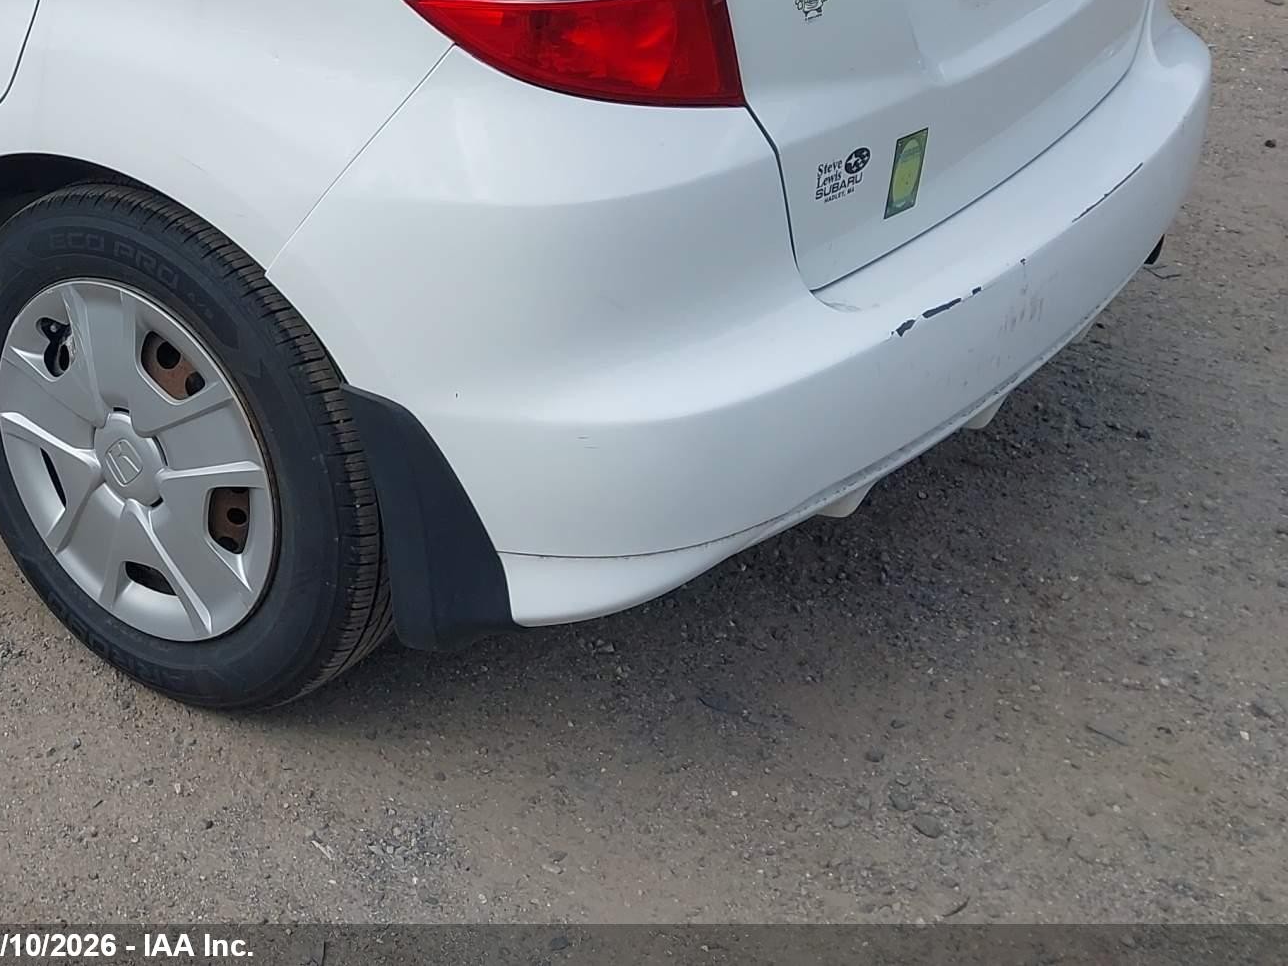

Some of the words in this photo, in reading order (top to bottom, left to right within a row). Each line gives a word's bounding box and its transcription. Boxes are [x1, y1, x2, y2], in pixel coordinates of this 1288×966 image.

[816, 171, 842, 189] Lewis
[817, 160, 843, 177] Steve
[815, 172, 863, 200] SUBARU
[49, 233, 105, 252] ECO
[113, 240, 180, 287] PRO
